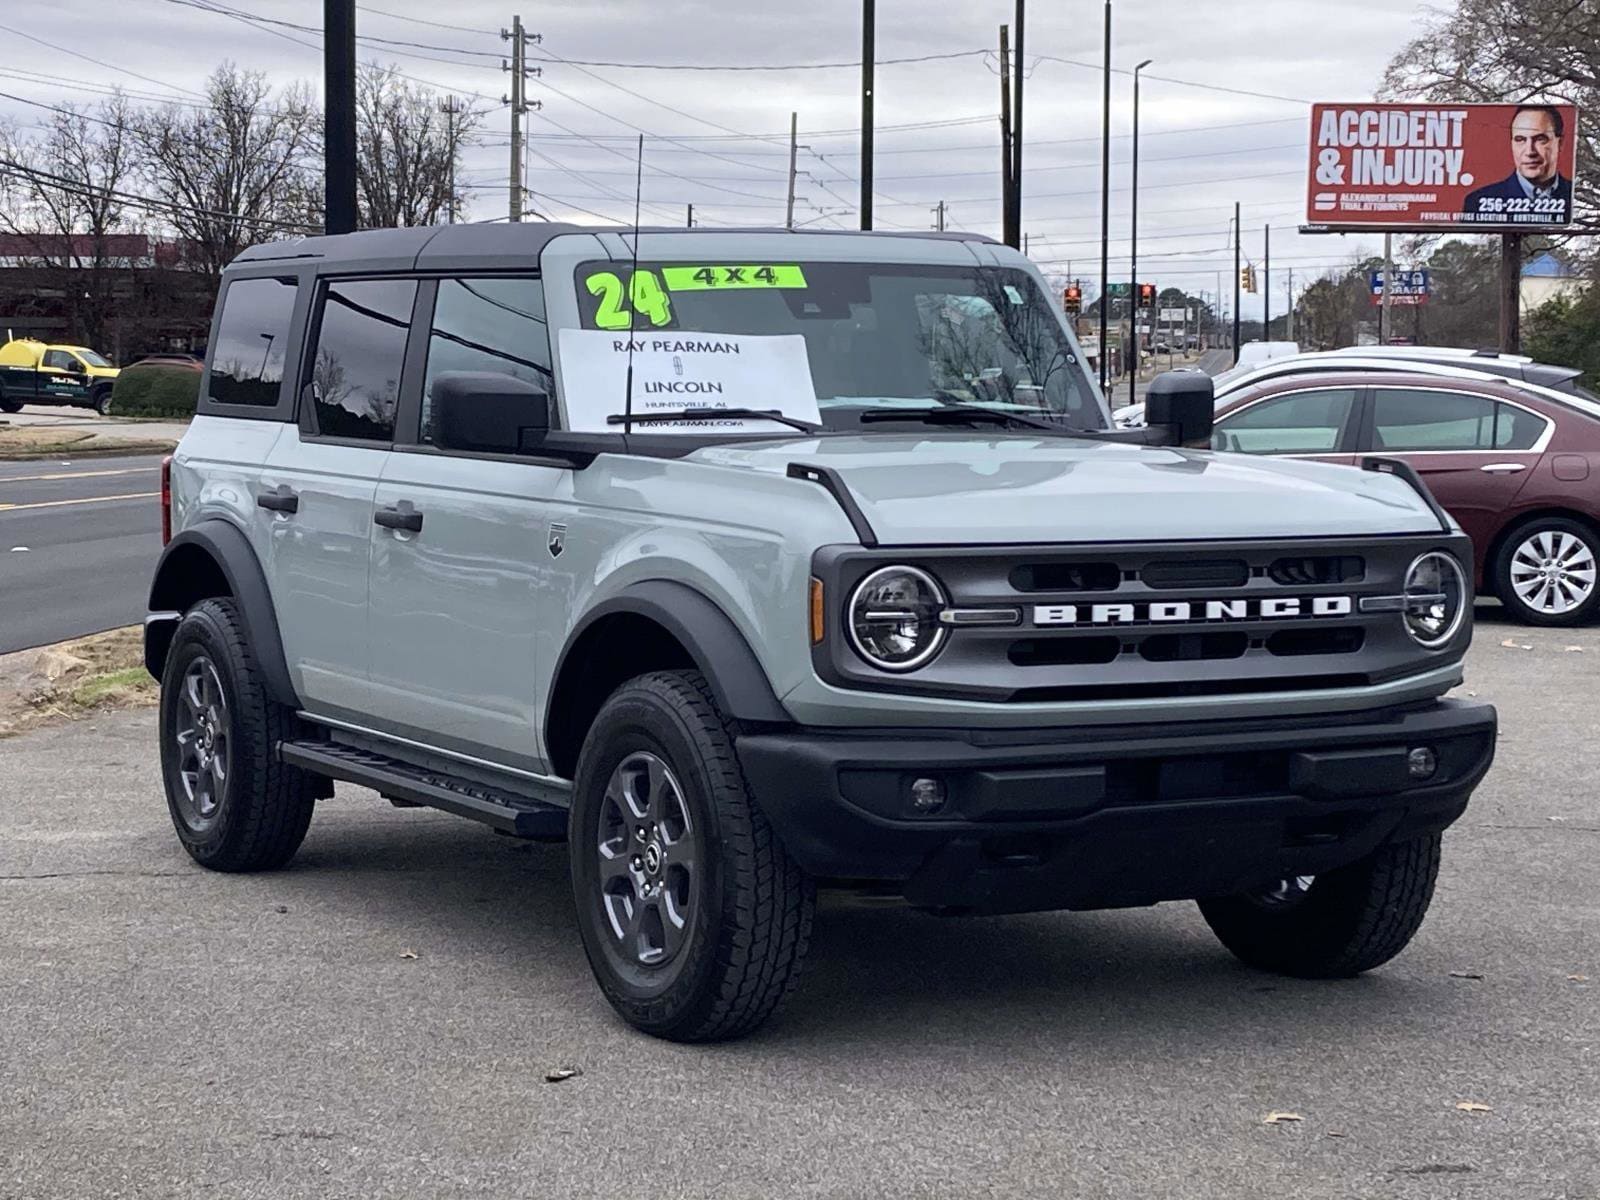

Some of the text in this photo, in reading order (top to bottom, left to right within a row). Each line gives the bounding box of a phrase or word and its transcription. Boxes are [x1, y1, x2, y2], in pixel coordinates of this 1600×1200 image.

[1318, 110, 1468, 147] ACCIDENT
[1316, 148, 1474, 186] & INJURY.
[1341, 193, 1386, 202] ALEXANDER
[1362, 202, 1408, 211] ATTORNEYS
[1479, 197, 1565, 213] 256-222-2222
[1420, 212, 1450, 221] PHYSICAL
[1452, 213, 1475, 221] OFFICE
[1476, 213, 1507, 222] LOCATION
[586, 271, 672, 330] 24
[613, 341, 740, 354] RAY PEARMAN
[645, 382, 723, 393] LINCOLN
[1033, 597, 1351, 624] BRONCO
